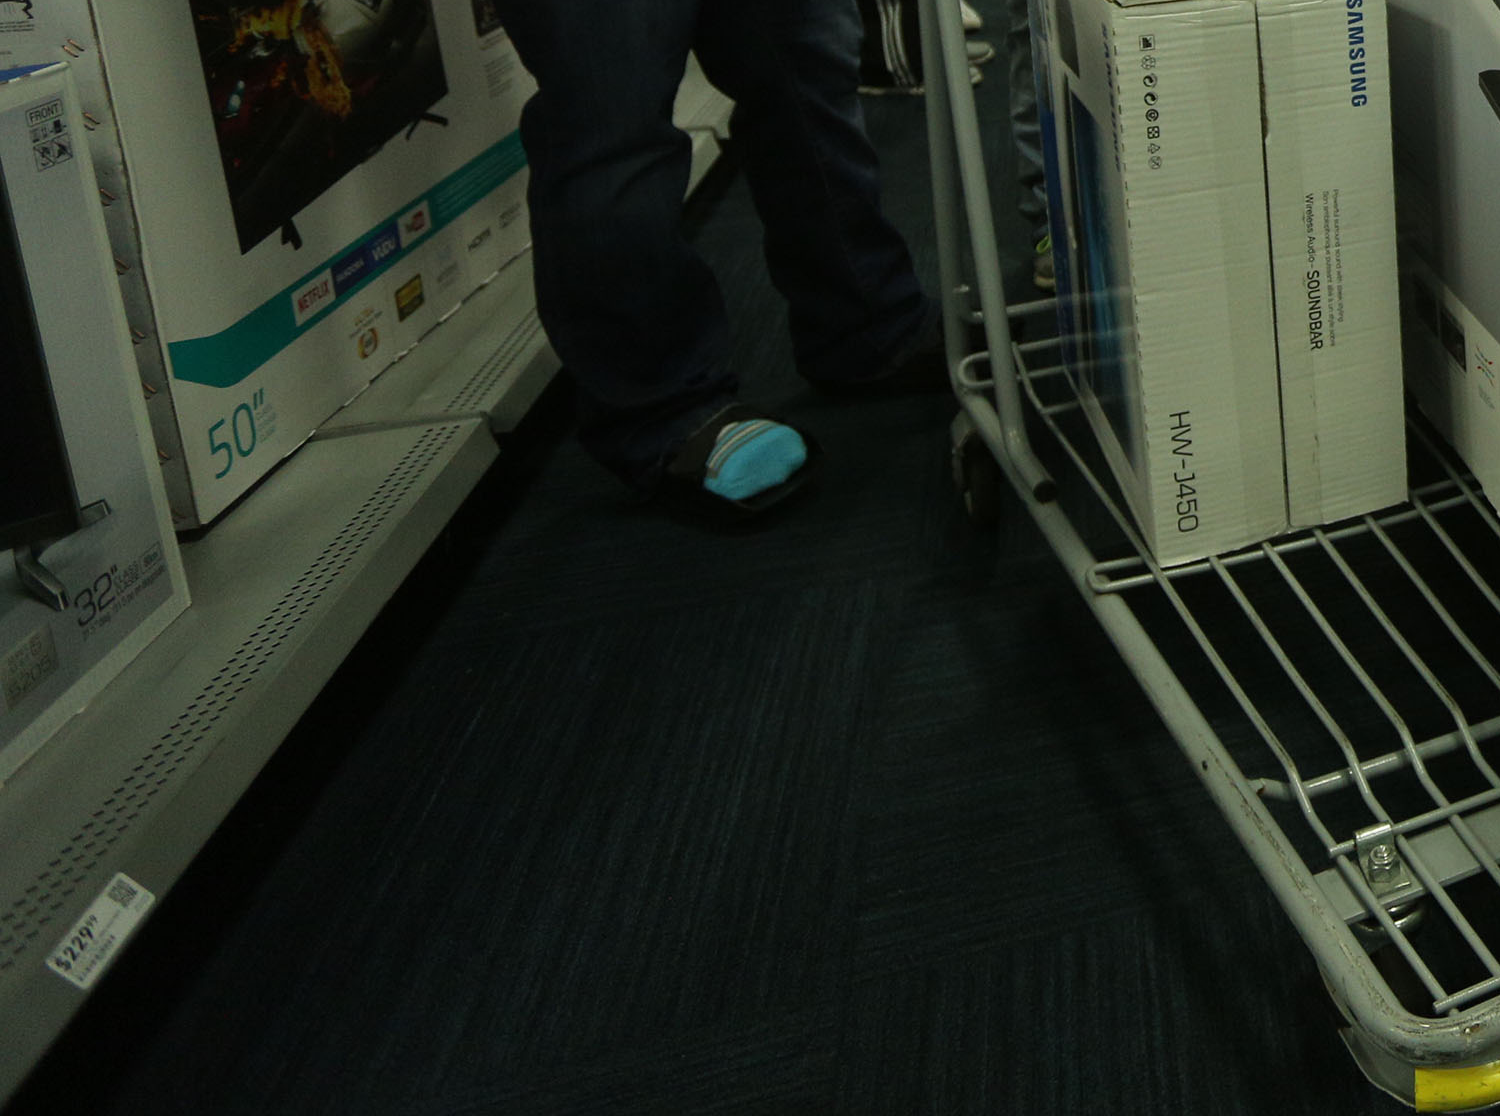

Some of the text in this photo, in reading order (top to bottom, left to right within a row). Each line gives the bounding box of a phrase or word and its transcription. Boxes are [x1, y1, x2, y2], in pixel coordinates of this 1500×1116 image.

[29, 102, 60, 123] FRONT
[1305, 193, 1315, 234] Wireless
[298, 280, 330, 313] NETFLIX
[1307, 270, 1324, 351] SOUNDBAR
[208, 387, 264, 480] 50"
[1169, 410, 1200, 535] HW-J450
[74, 564, 118, 627] 32"
